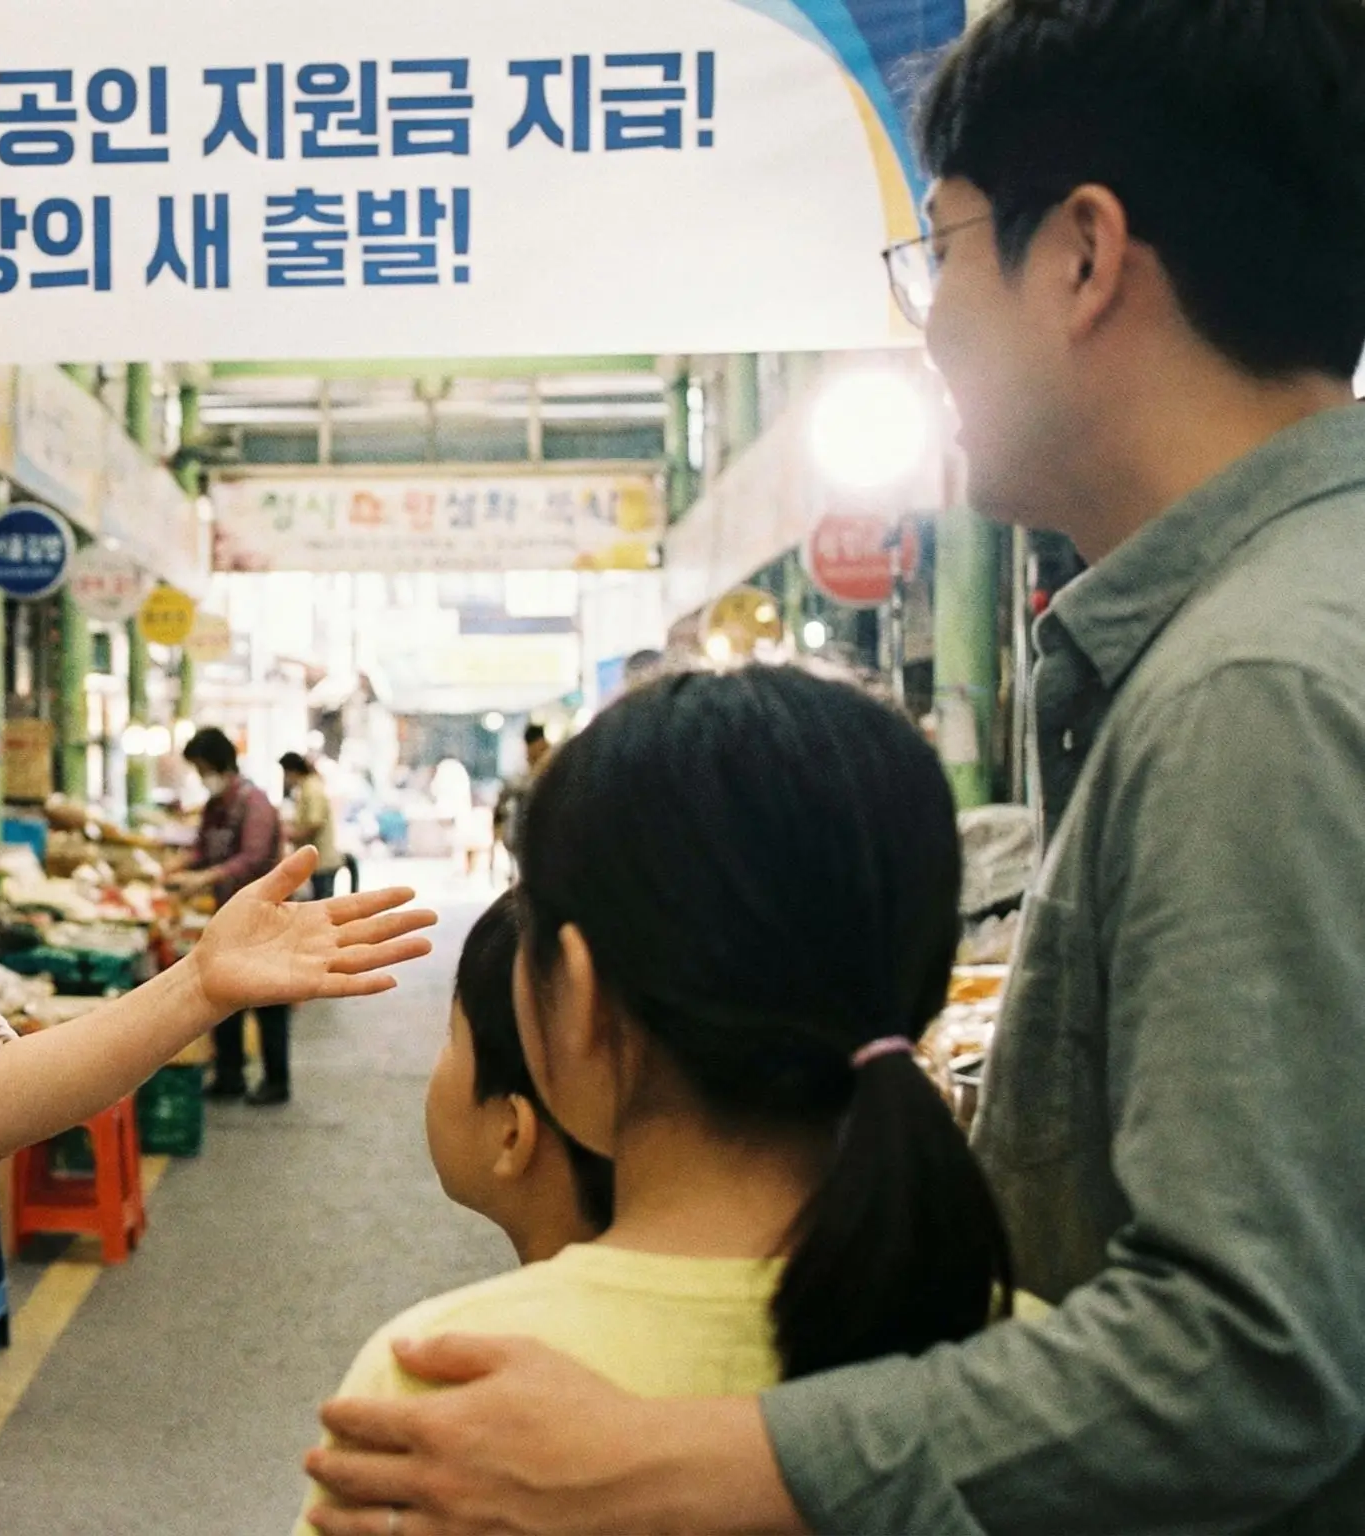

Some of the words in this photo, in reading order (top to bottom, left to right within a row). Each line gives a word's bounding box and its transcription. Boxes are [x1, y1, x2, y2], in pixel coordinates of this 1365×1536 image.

[203, 57, 474, 160] 지원금
[507, 51, 715, 152] 지급!
[145, 193, 231, 288] 새
[264, 186, 471, 287] 출발!
